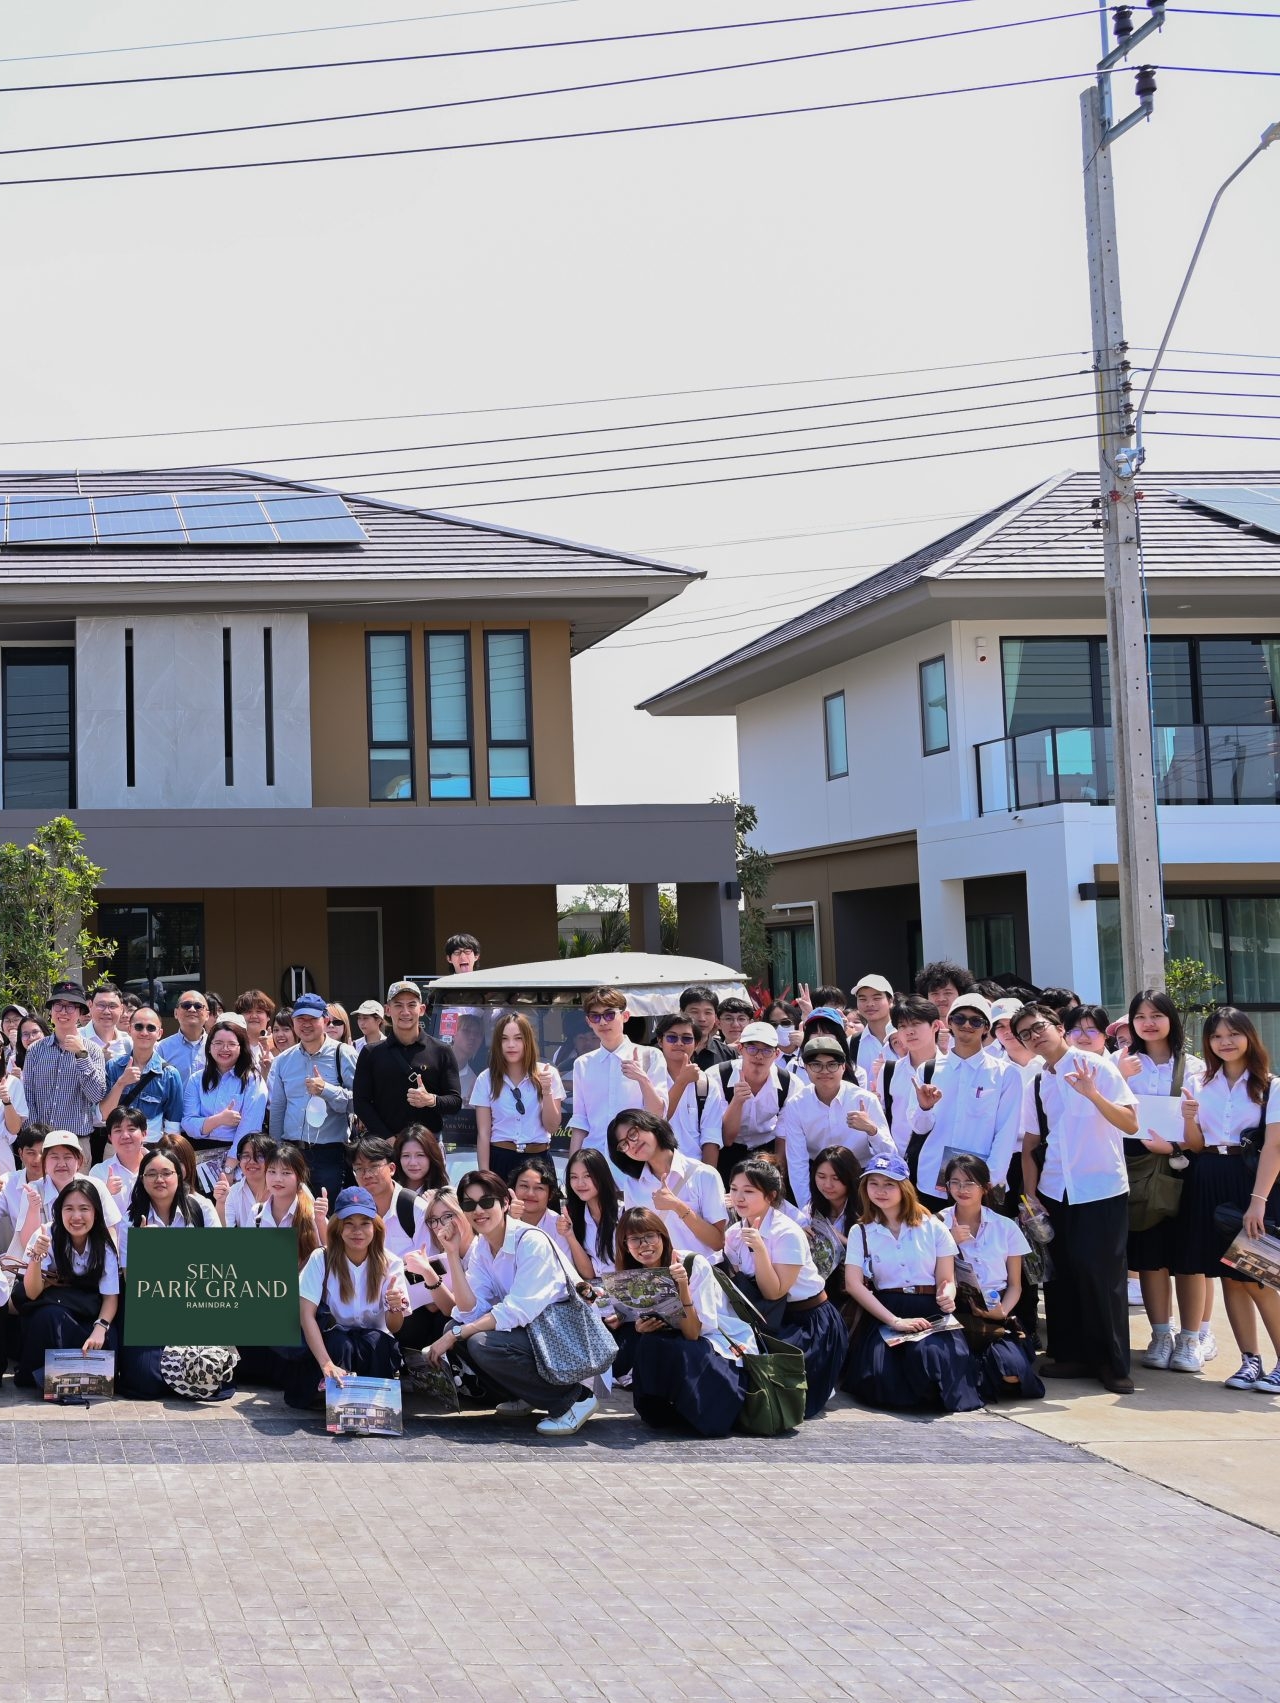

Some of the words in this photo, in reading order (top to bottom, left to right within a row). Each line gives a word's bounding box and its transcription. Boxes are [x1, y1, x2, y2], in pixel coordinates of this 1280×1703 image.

[187, 1263, 238, 1280] SENA
[137, 1280, 198, 1298] PARK
[205, 1280, 288, 1298] GRAND
